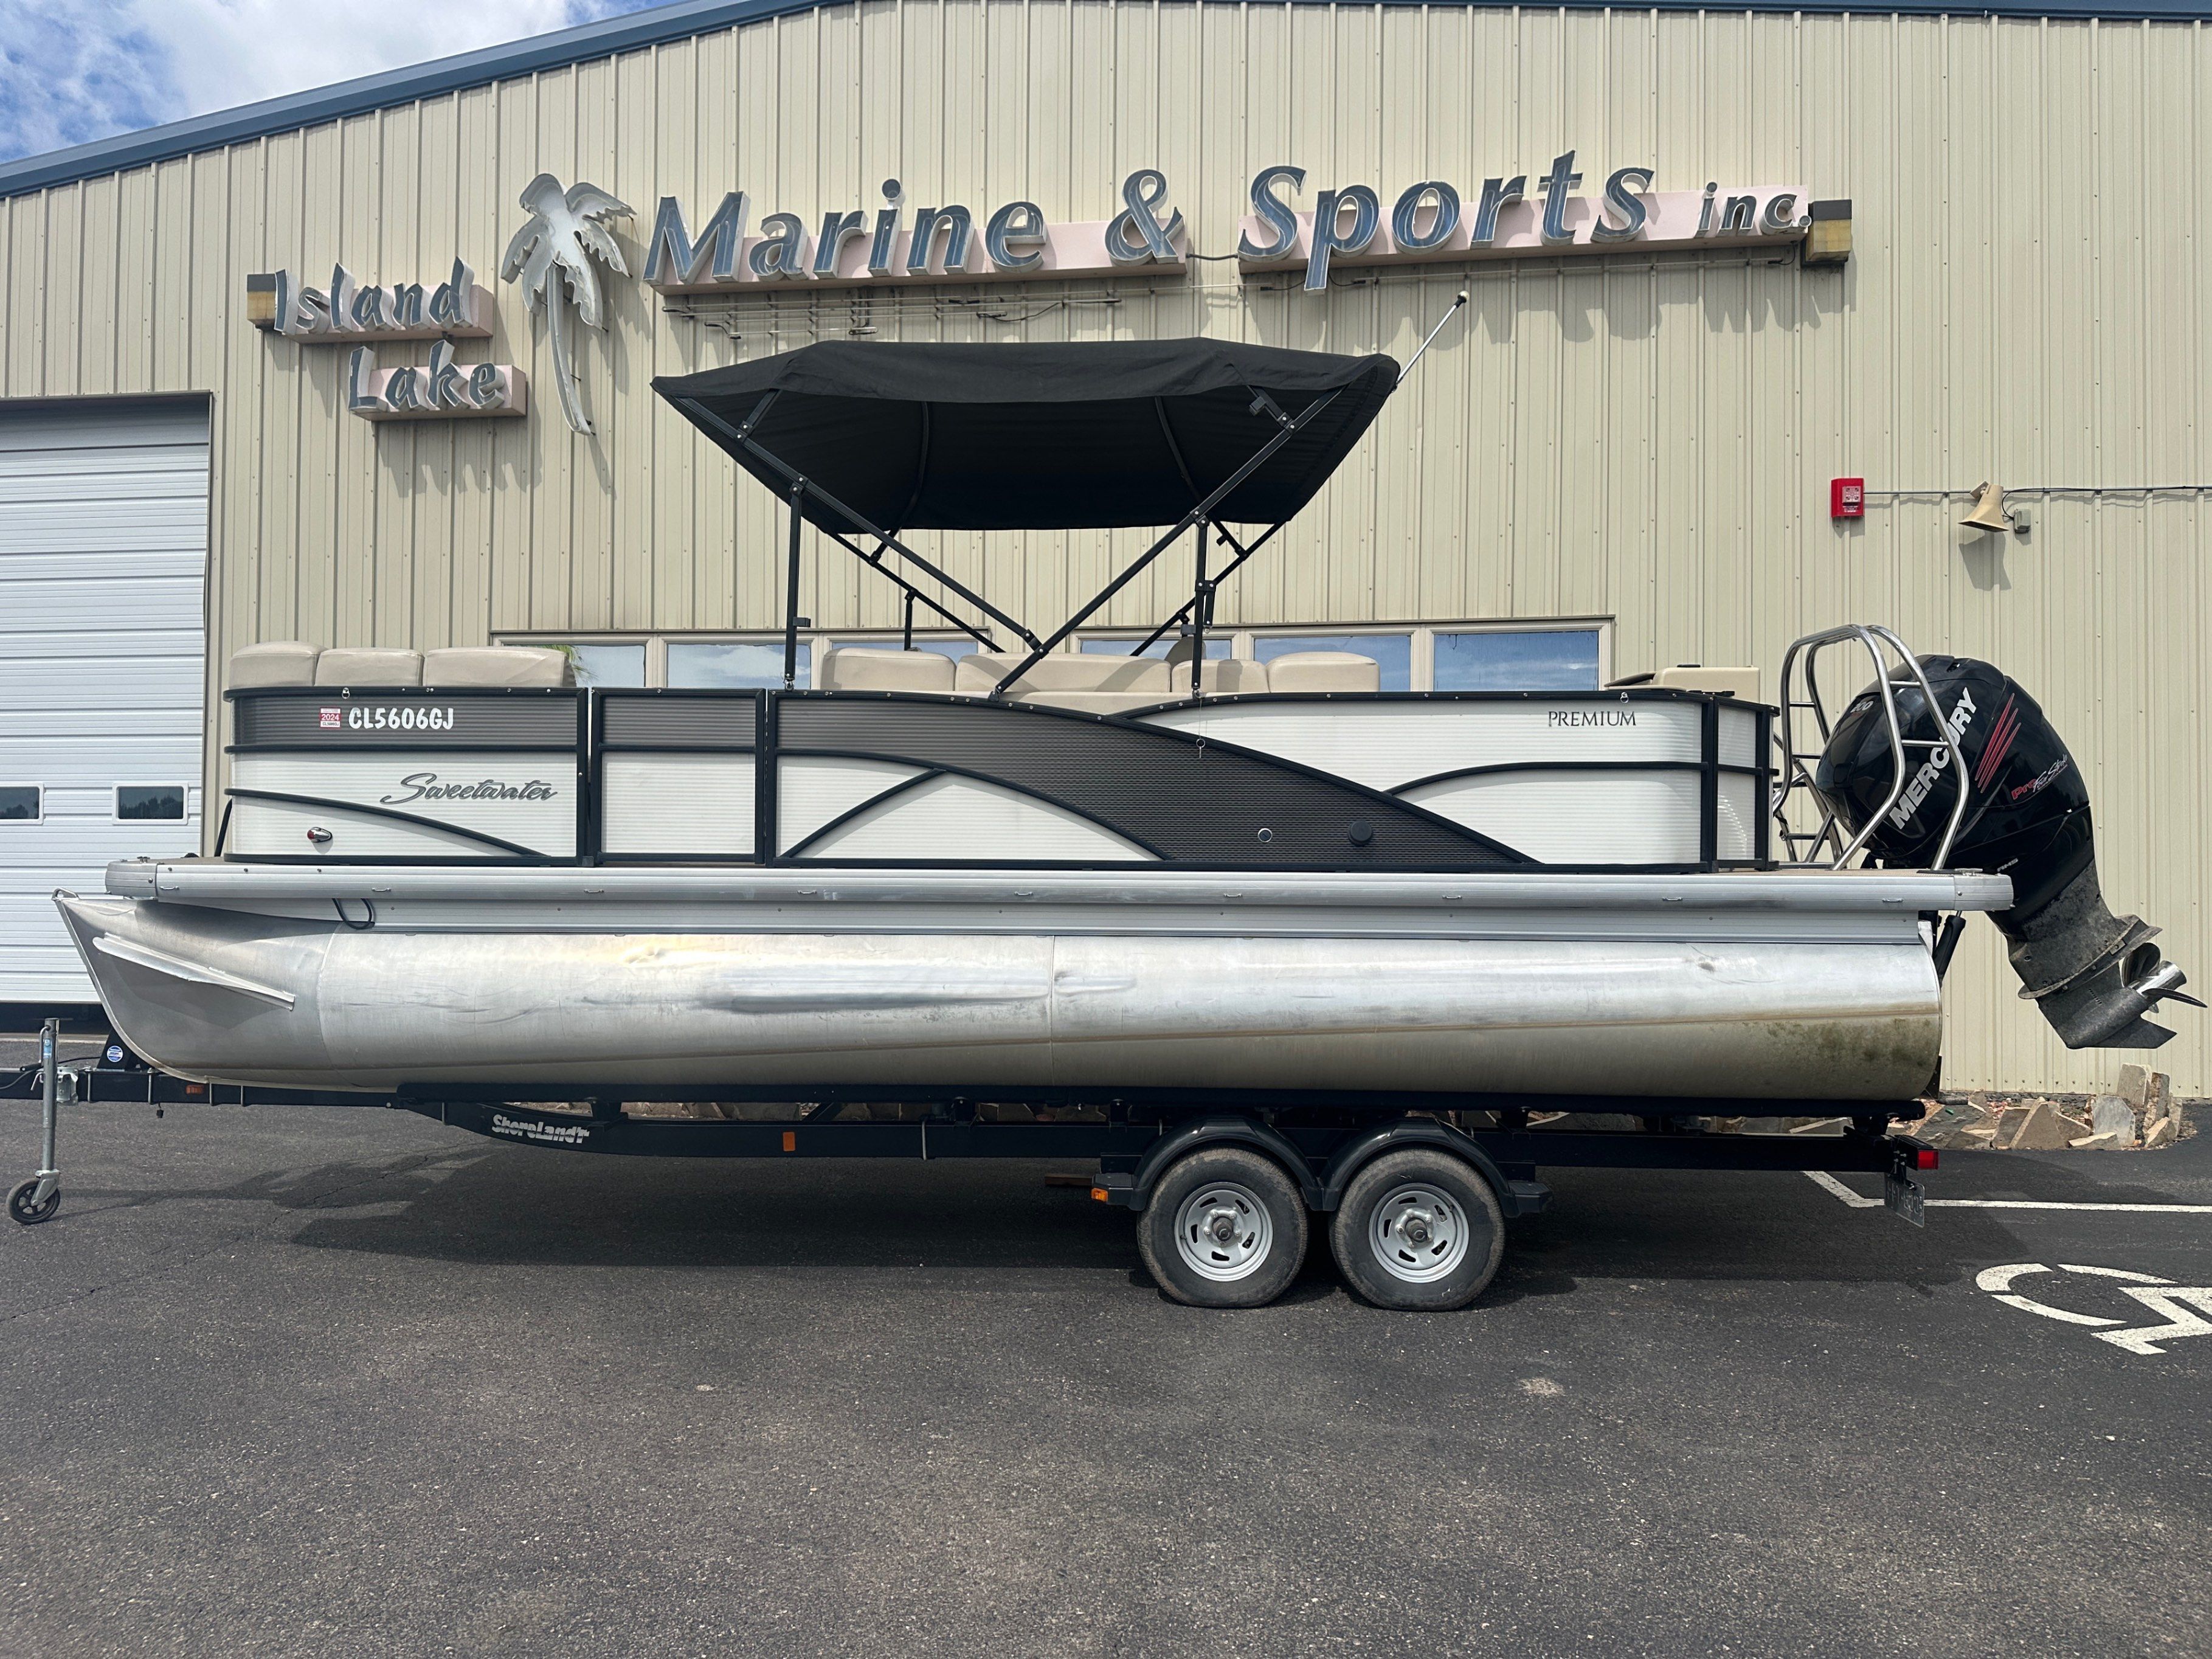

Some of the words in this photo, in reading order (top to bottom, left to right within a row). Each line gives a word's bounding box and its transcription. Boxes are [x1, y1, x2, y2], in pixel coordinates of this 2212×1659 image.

[643, 178, 1047, 285] Marine
[1104, 168, 1184, 266] &
[1237, 150, 1655, 295] Sports
[274, 256, 474, 335] Island
[347, 339, 505, 414] Lake
[348, 707, 454, 730] CL5606GJ
[1548, 711, 1637, 727] PREMIUM
[379, 772, 558, 805] Sweetwater
[1889, 687, 1977, 830] MERCURY
